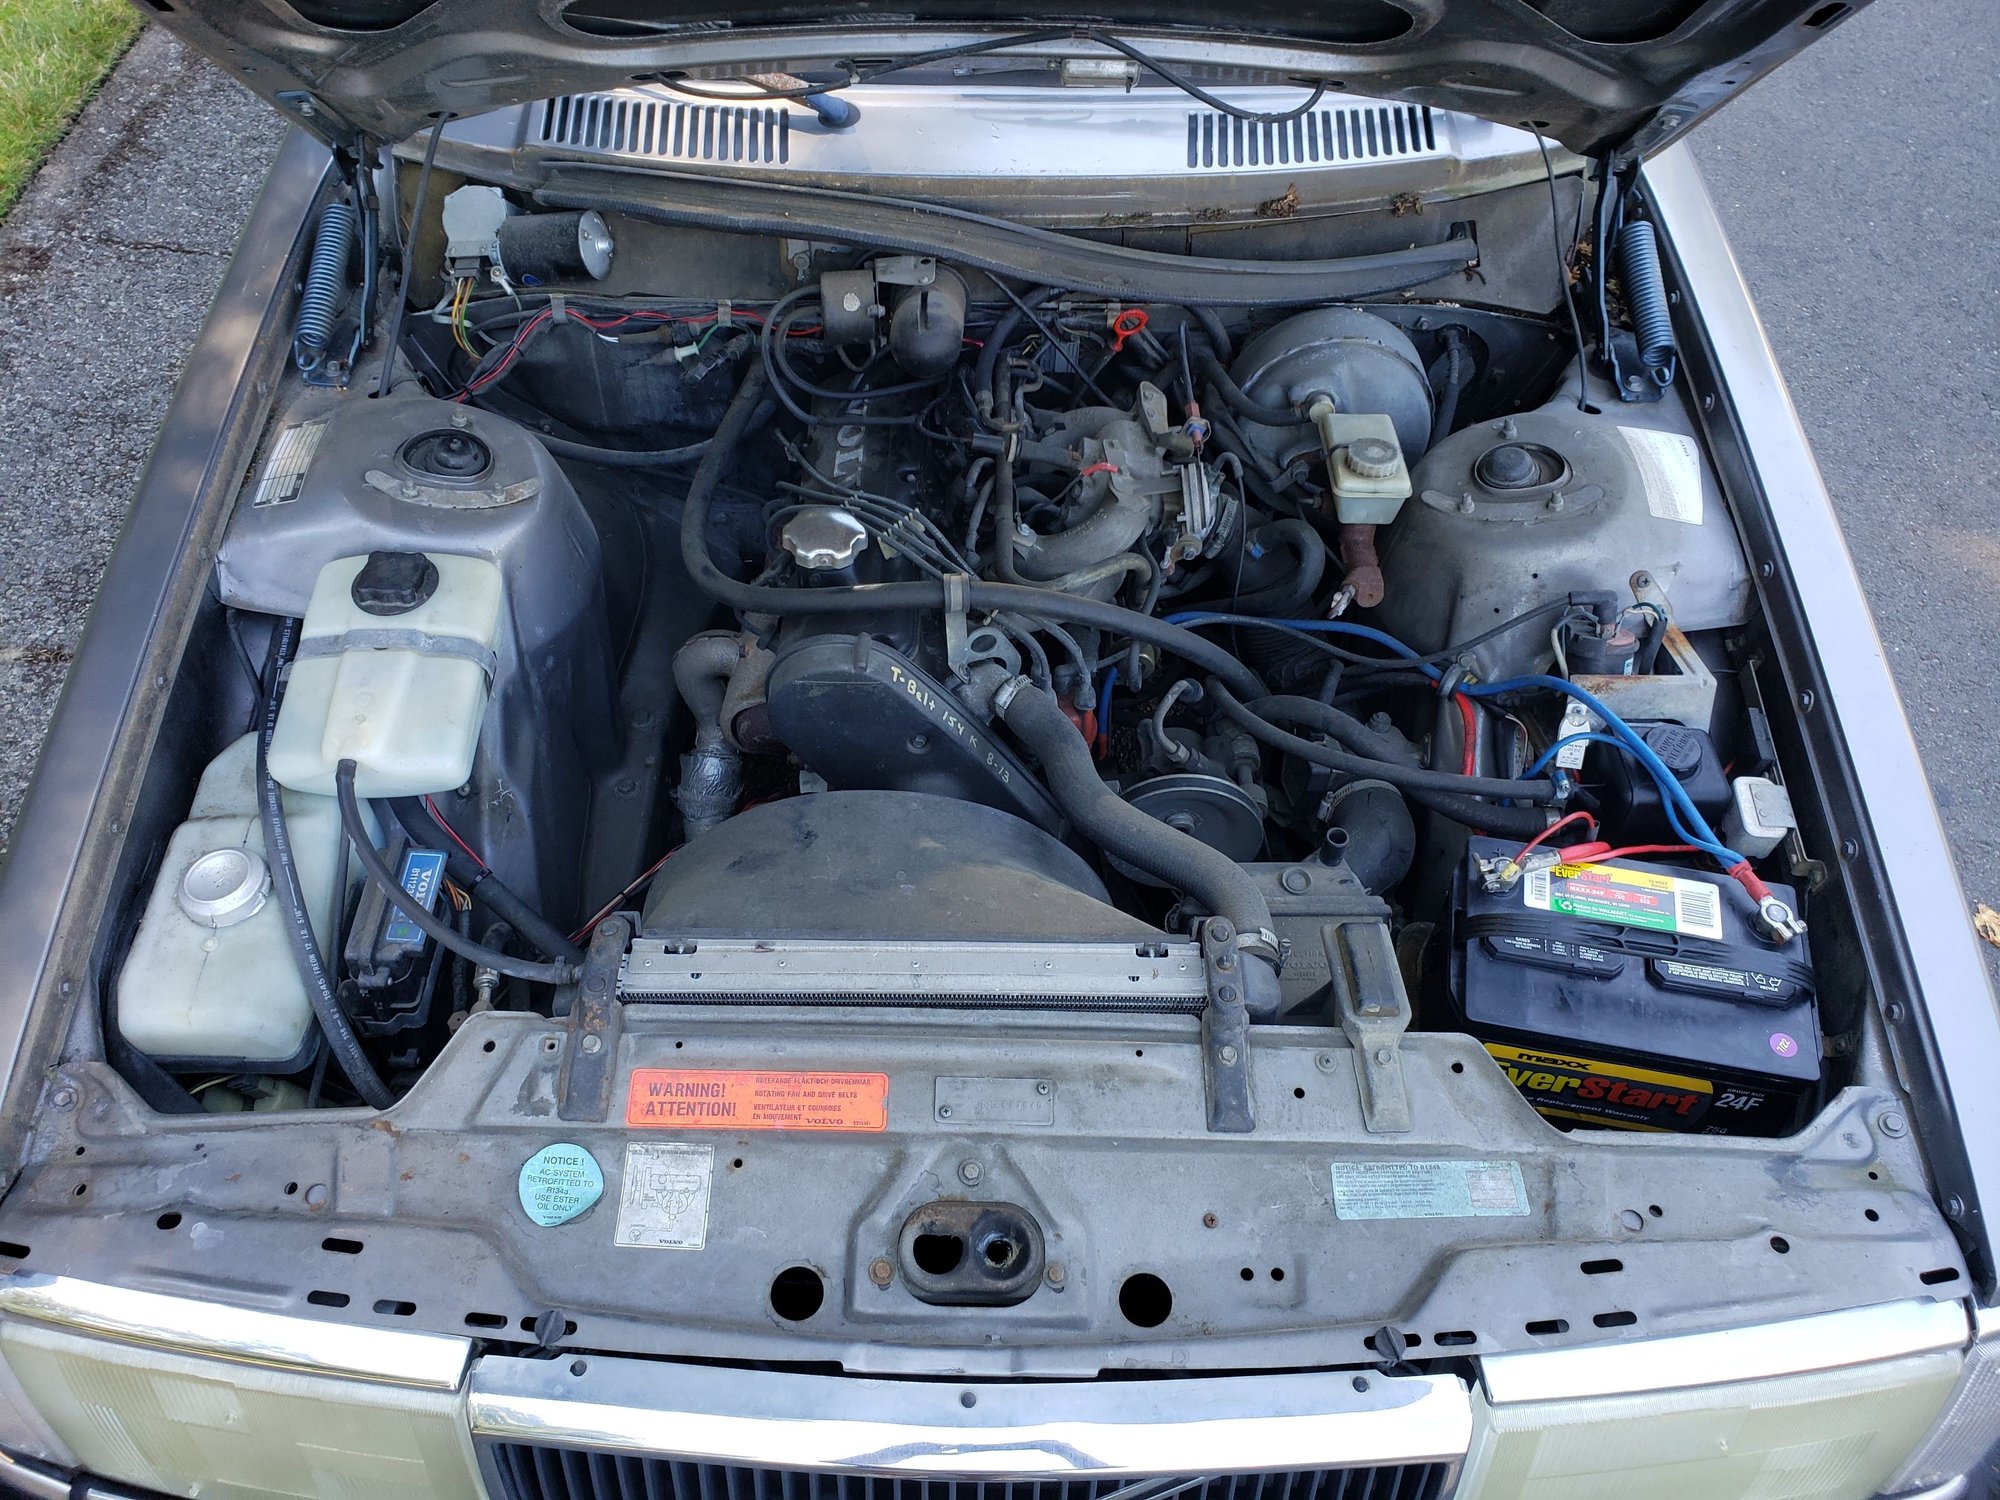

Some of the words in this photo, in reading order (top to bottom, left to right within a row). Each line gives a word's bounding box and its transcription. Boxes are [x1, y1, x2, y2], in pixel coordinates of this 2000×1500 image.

[891, 665, 936, 711] T-Belt
[969, 735, 978, 748] K
[986, 752, 1010, 784] 8-13
[1555, 866, 1612, 886] EverStart
[304, 942, 312, 951] 12
[308, 953, 320, 975] FREON
[1517, 1052, 1593, 1071] maxx
[648, 1082, 726, 1098] WARNING!
[754, 1090, 786, 1098] ROTATING
[646, 1100, 736, 1117] ATTENTION!
[754, 1104, 796, 1112] VENTILATEUR
[1536, 1097, 1602, 1112] Replacement
[1604, 1108, 1650, 1121] Warranty
[1714, 1092, 1764, 1111] 24F
[544, 1156, 580, 1166] NOTICE
[527, 1174, 581, 1187] RETROFITTED
[584, 1180, 594, 1188] TO
[534, 1193, 552, 1202] USE
[553, 1195, 580, 1204] ESTER
[536, 1202, 550, 1210] OIL
[552, 1204, 574, 1212] ONLY
